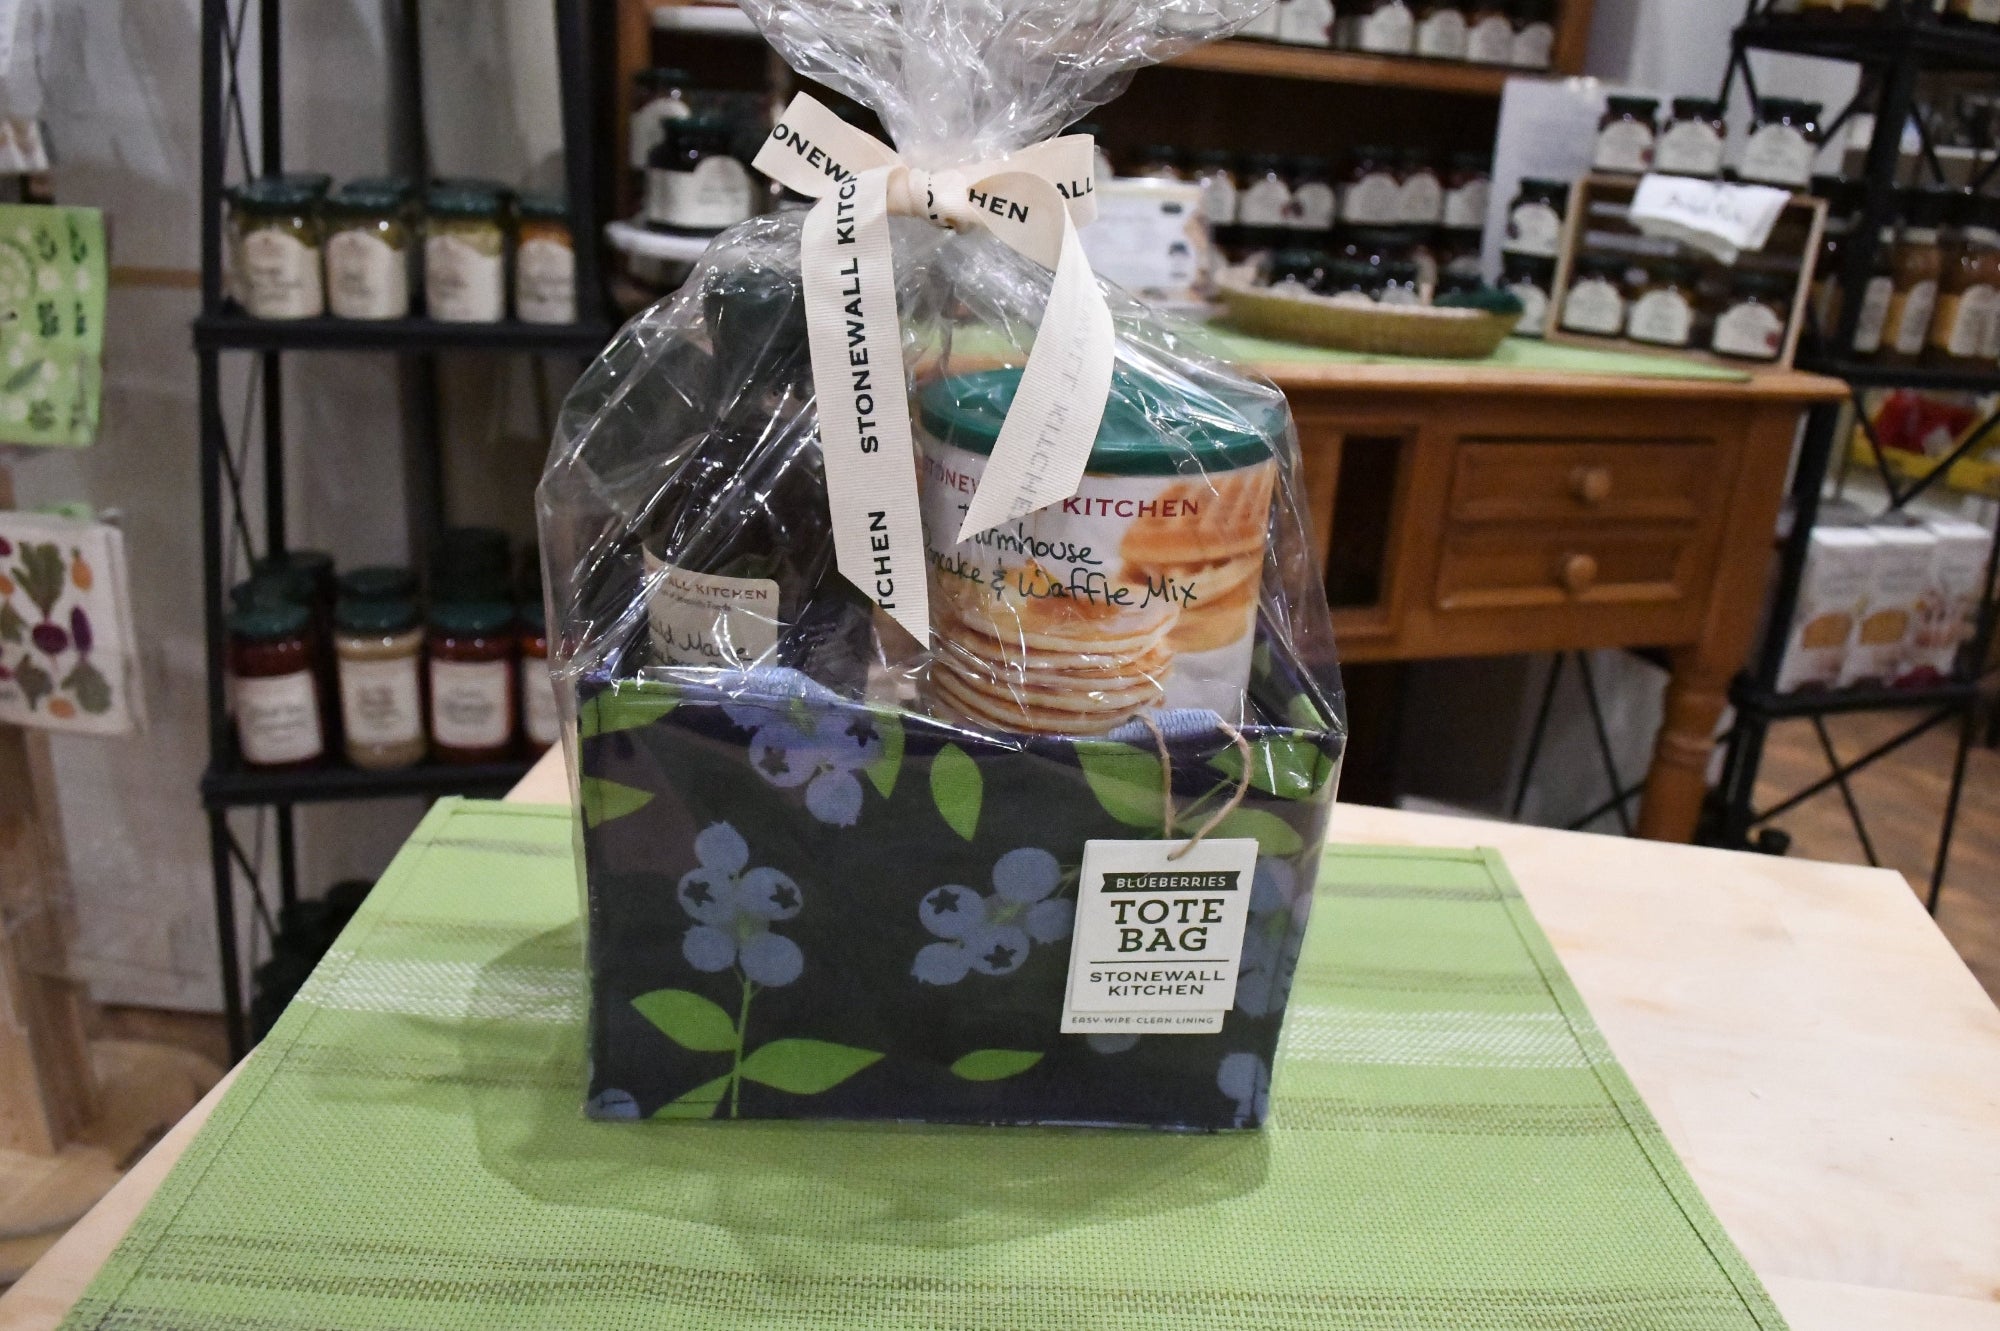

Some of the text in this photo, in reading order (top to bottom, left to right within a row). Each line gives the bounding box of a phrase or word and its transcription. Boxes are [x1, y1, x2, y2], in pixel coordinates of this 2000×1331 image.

[841, 257, 879, 453] STONEWALL
[1062, 497, 1199, 518] KITCHEN
[695, 584, 768, 600] KITCHEN
[1018, 567, 1135, 607] Waffle
[1140, 575, 1198, 609] Mix
[1116, 876, 1227, 889] BLUEBERRIES
[1110, 898, 1225, 925] TOTE
[1117, 927, 1208, 953] BAG
[1090, 970, 1226, 983] STONEWALL
[1108, 984, 1205, 997] KITCHEN
[1136, 1016, 1172, 1025] CLEAN
[1175, 1016, 1214, 1025] LINING
